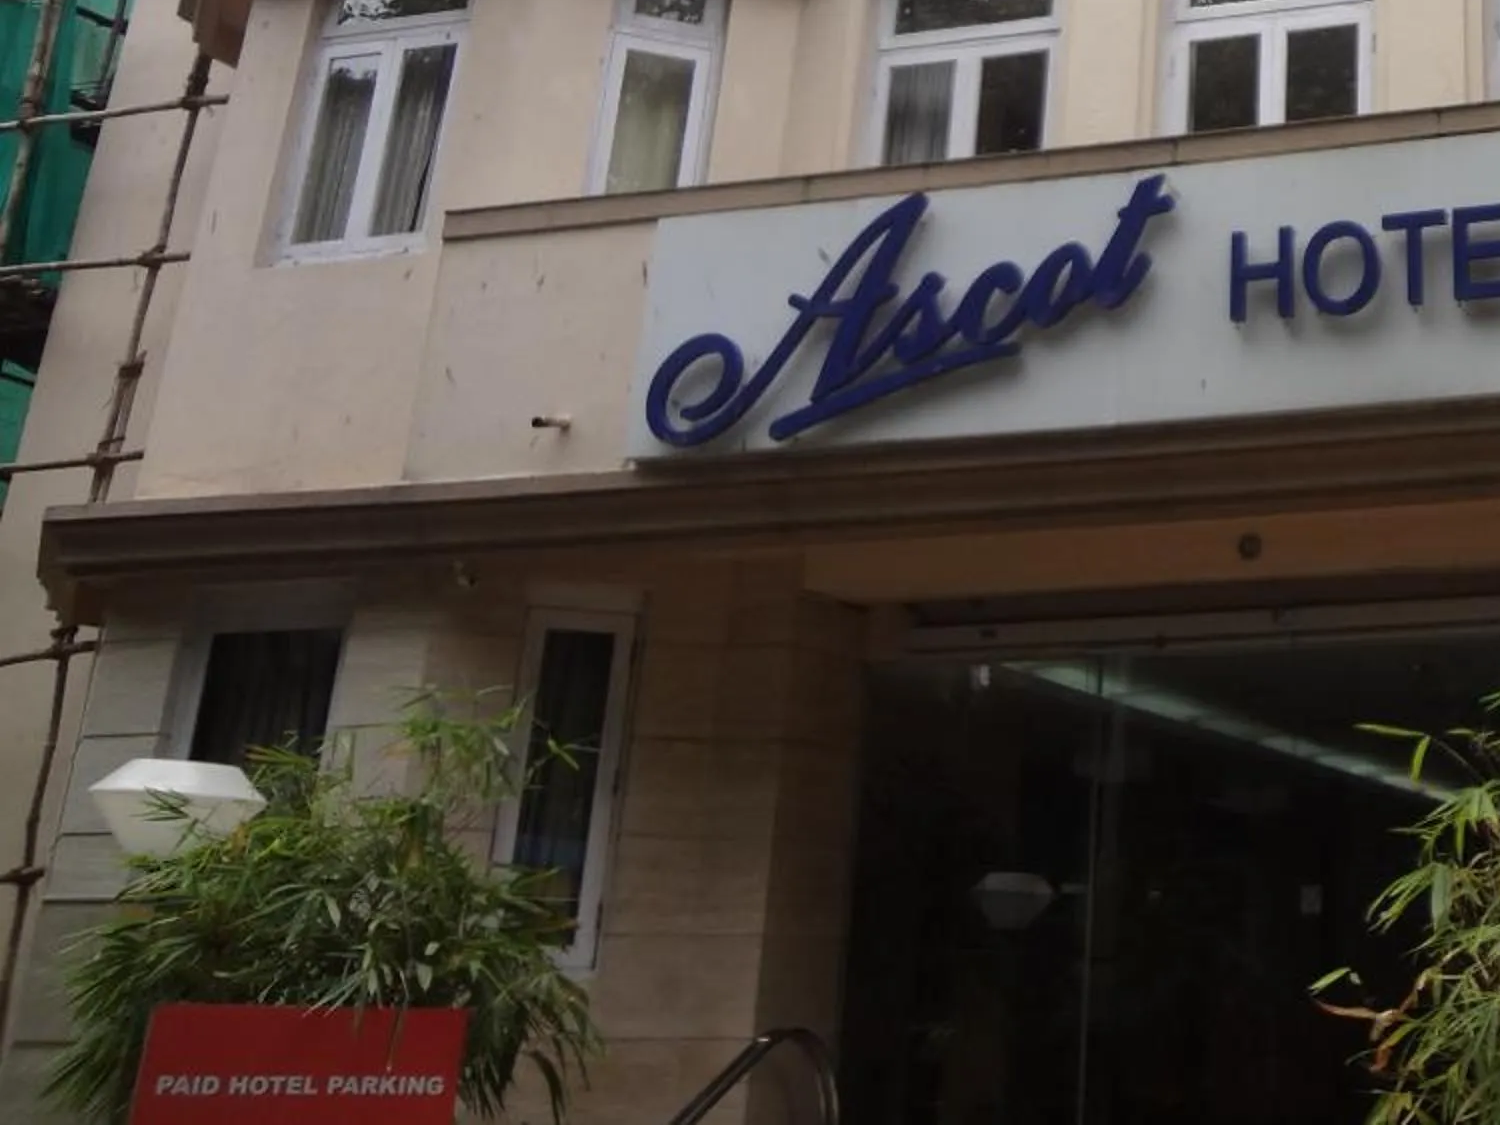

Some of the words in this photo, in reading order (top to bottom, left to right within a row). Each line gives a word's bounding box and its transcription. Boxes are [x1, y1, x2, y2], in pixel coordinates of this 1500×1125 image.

[645, 174, 1176, 449] Ascot
[155, 1074, 221, 1096] PAID
[228, 1074, 319, 1096] HOTEL
[326, 1074, 445, 1096] PARKING
